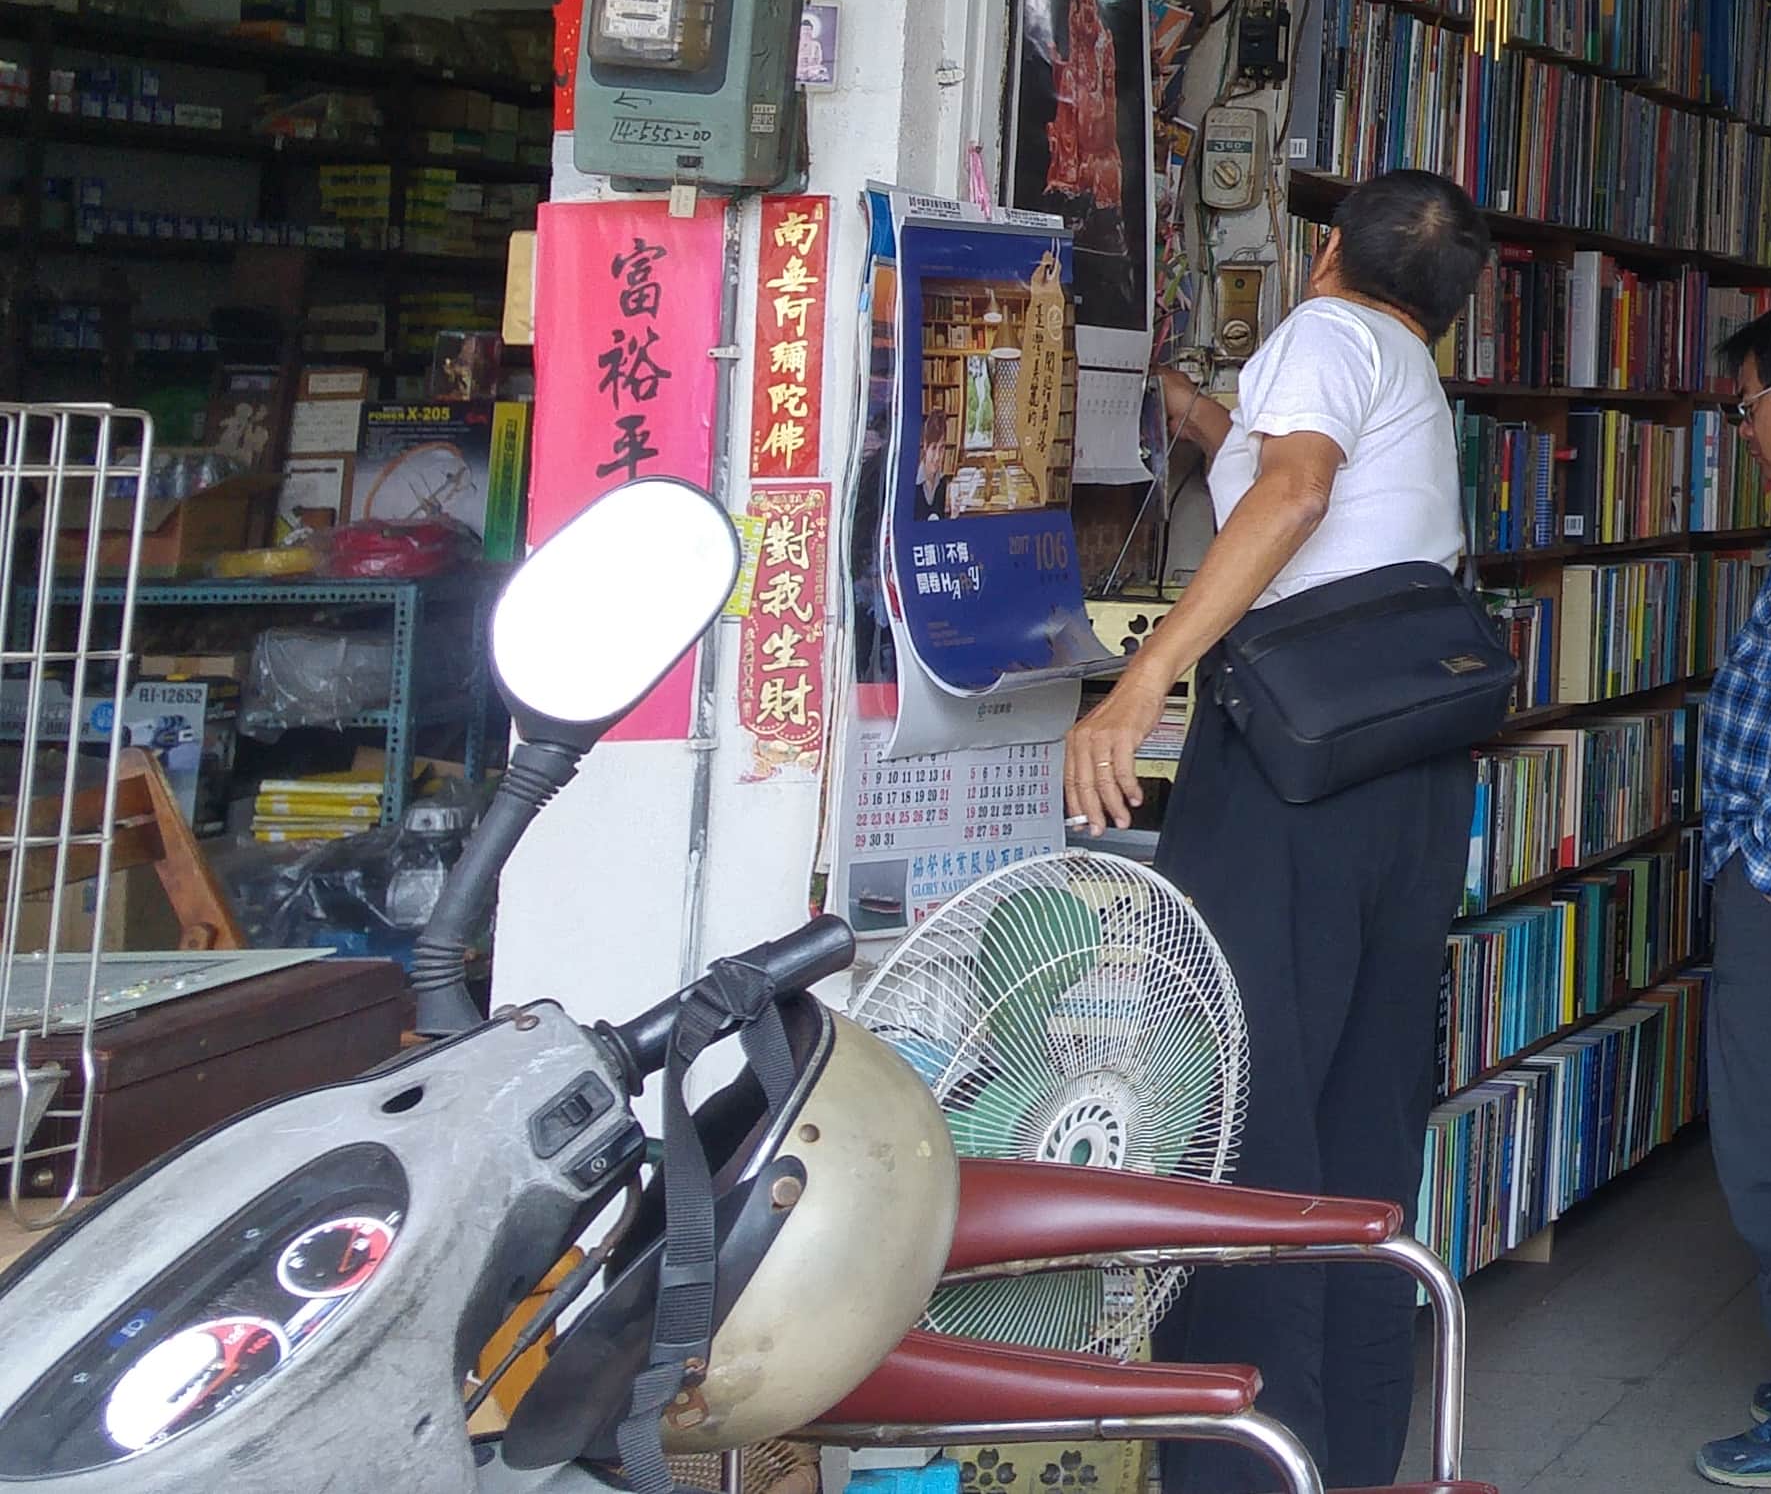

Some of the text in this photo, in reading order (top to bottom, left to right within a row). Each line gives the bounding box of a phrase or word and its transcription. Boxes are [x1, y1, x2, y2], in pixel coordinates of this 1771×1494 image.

[406, 406, 450, 421] X-205
[757, 514, 814, 727] 對我生財
